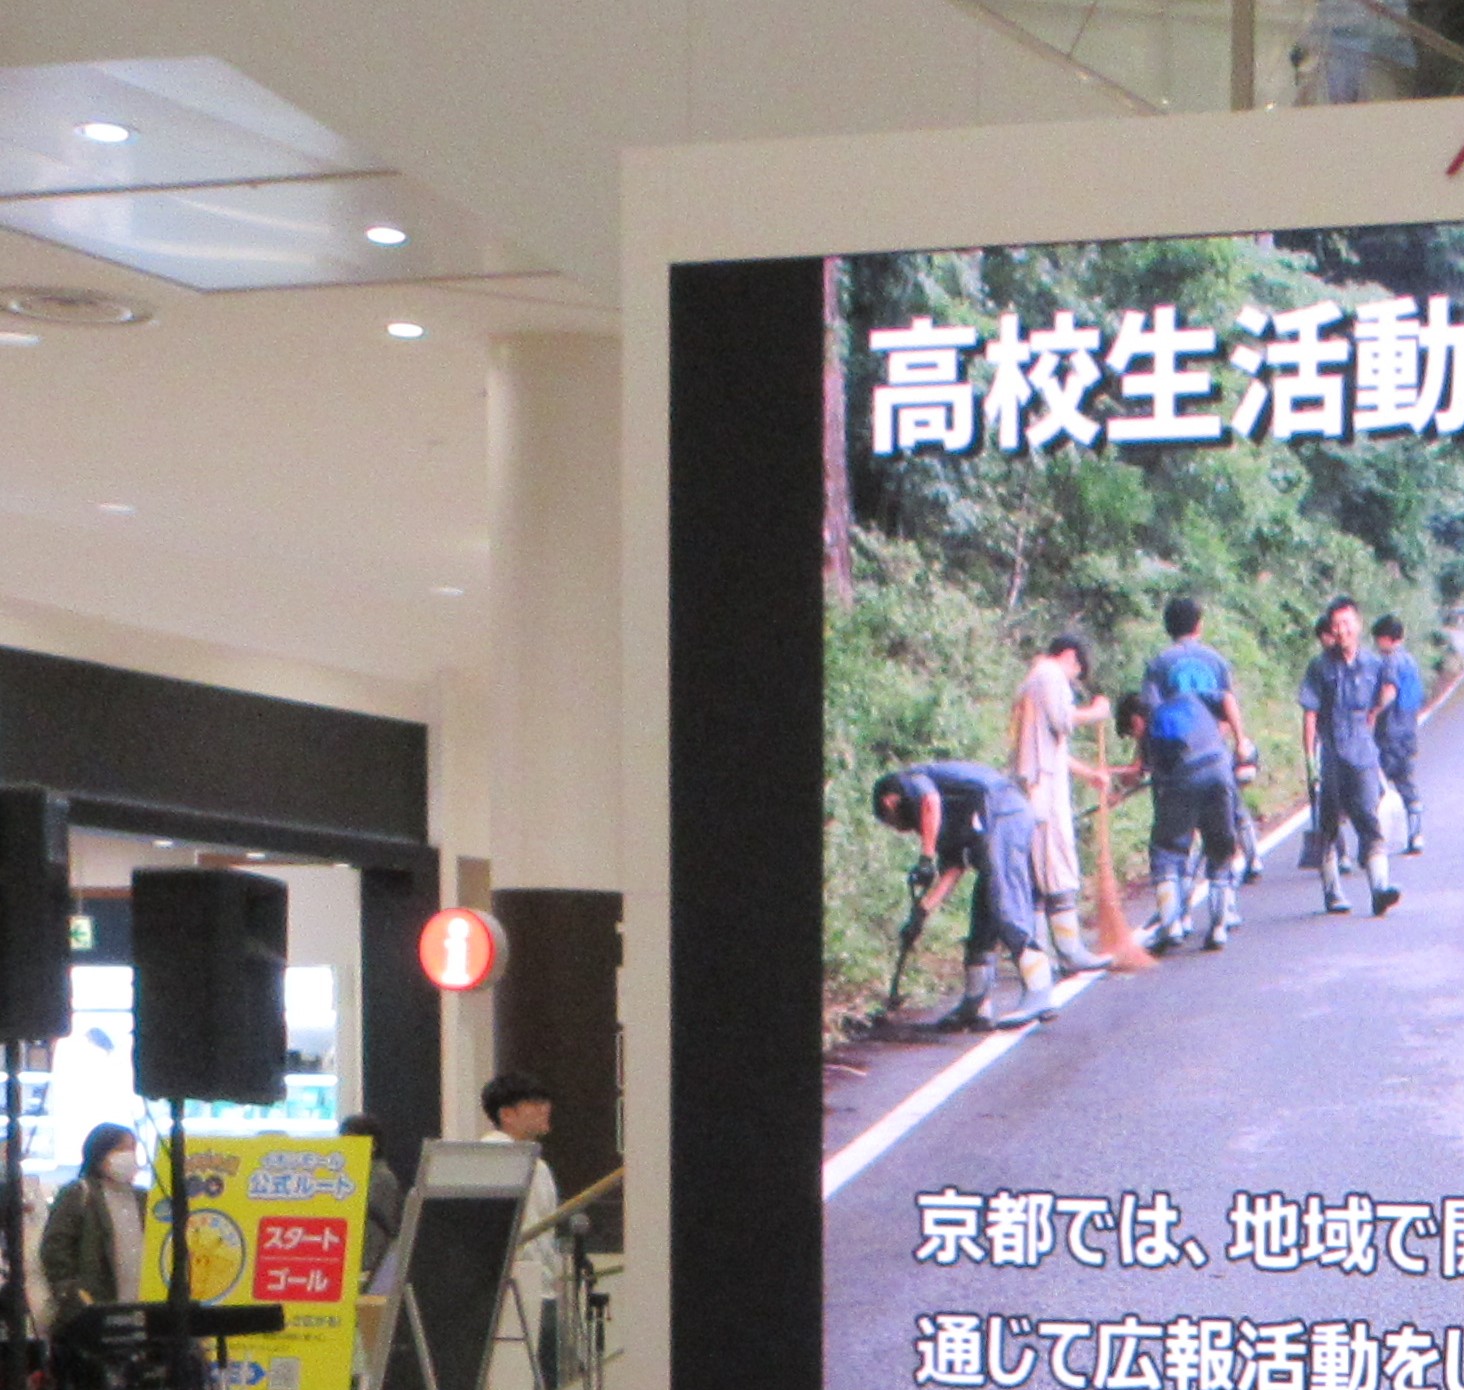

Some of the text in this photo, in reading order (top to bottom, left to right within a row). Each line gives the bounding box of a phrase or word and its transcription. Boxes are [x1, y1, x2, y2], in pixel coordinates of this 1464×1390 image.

[249, 1171, 354, 1200] 公式ルート
[263, 1225, 341, 1252] スタート
[266, 1267, 330, 1293] ゴール
